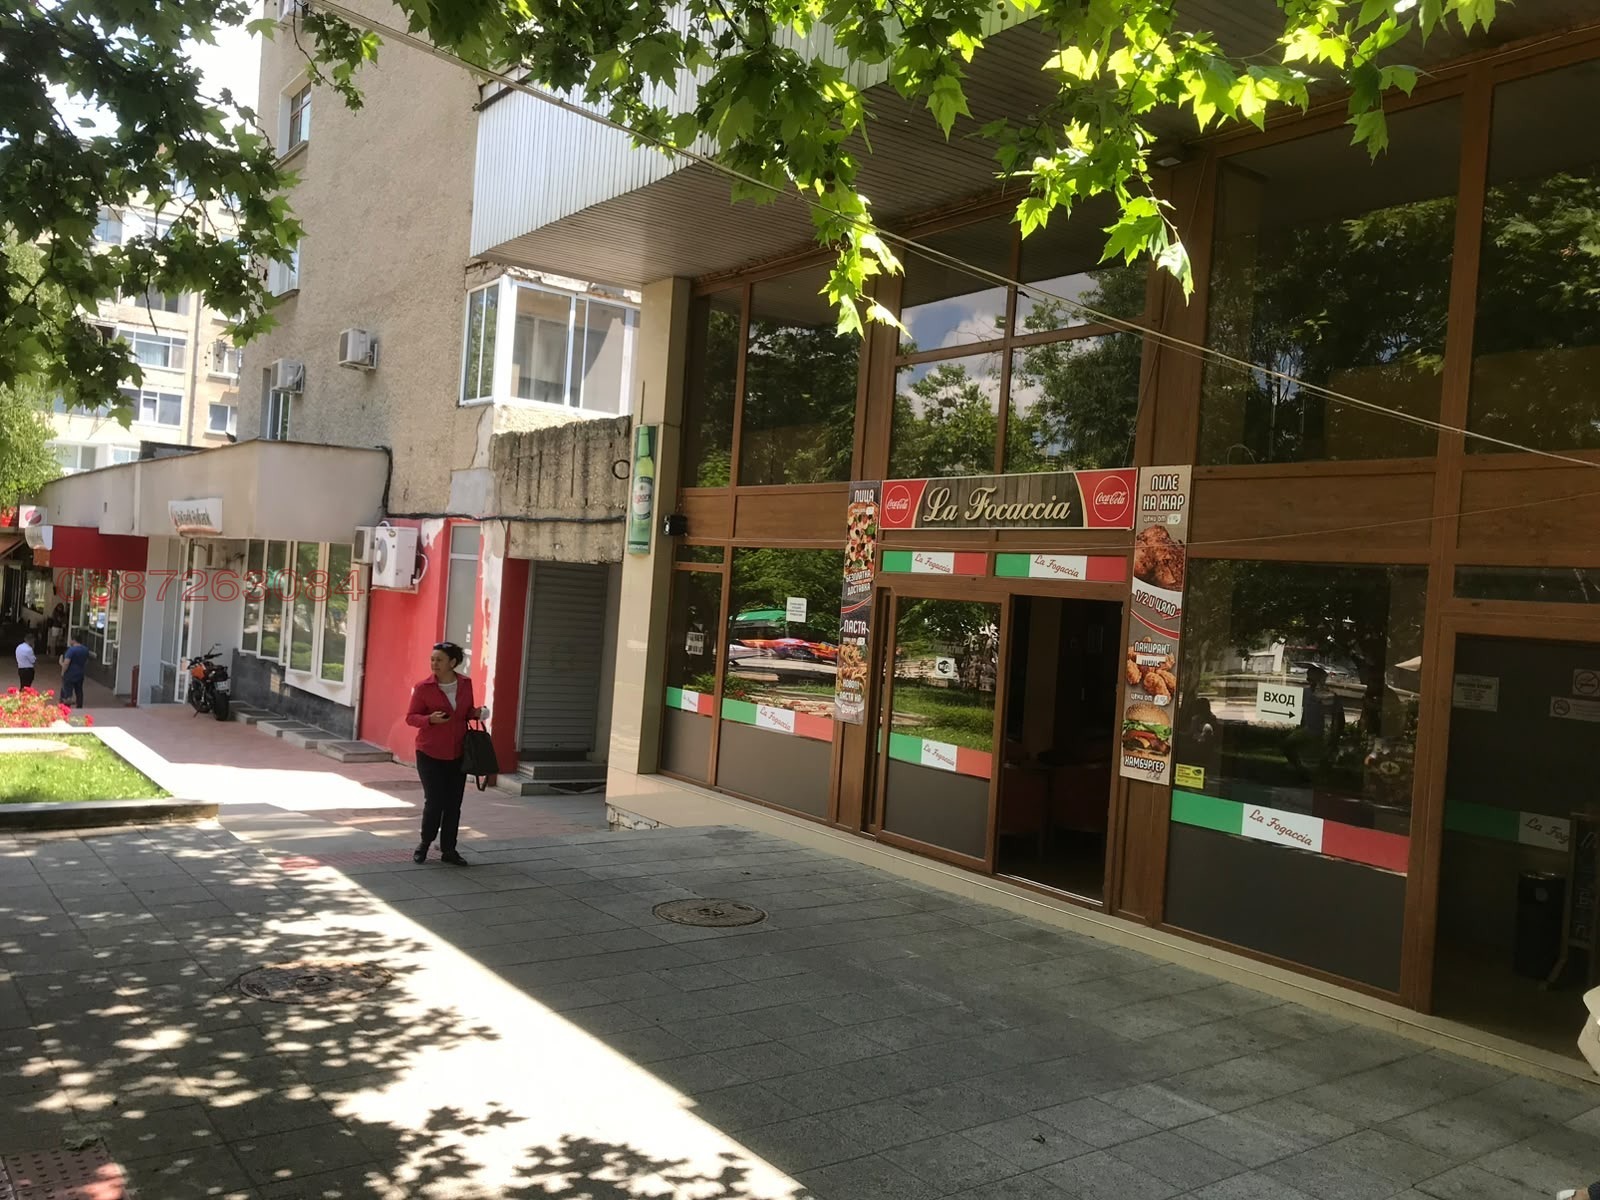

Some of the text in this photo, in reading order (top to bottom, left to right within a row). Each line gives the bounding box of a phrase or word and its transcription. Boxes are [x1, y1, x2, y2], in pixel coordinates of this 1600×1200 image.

[1151, 474, 1179, 490] ПИЛЕ
[854, 489, 875, 504] ПИЦА
[922, 485, 1071, 522] La Focaccia
[1142, 493, 1185, 511] НА ЖАР
[914, 553, 924, 563] La
[1034, 554, 1080, 578] La Fogaccia
[1136, 590, 1148, 604] 1/2
[1156, 597, 1176, 616] ЦЯЛО
[843, 619, 867, 635] ПАСТА
[1263, 691, 1296, 707] ВХОД
[1124, 755, 1165, 773] ХАМБУРГЕР
[1249, 809, 1313, 847] La Fogaccia
[1525, 816, 1542, 832] La
